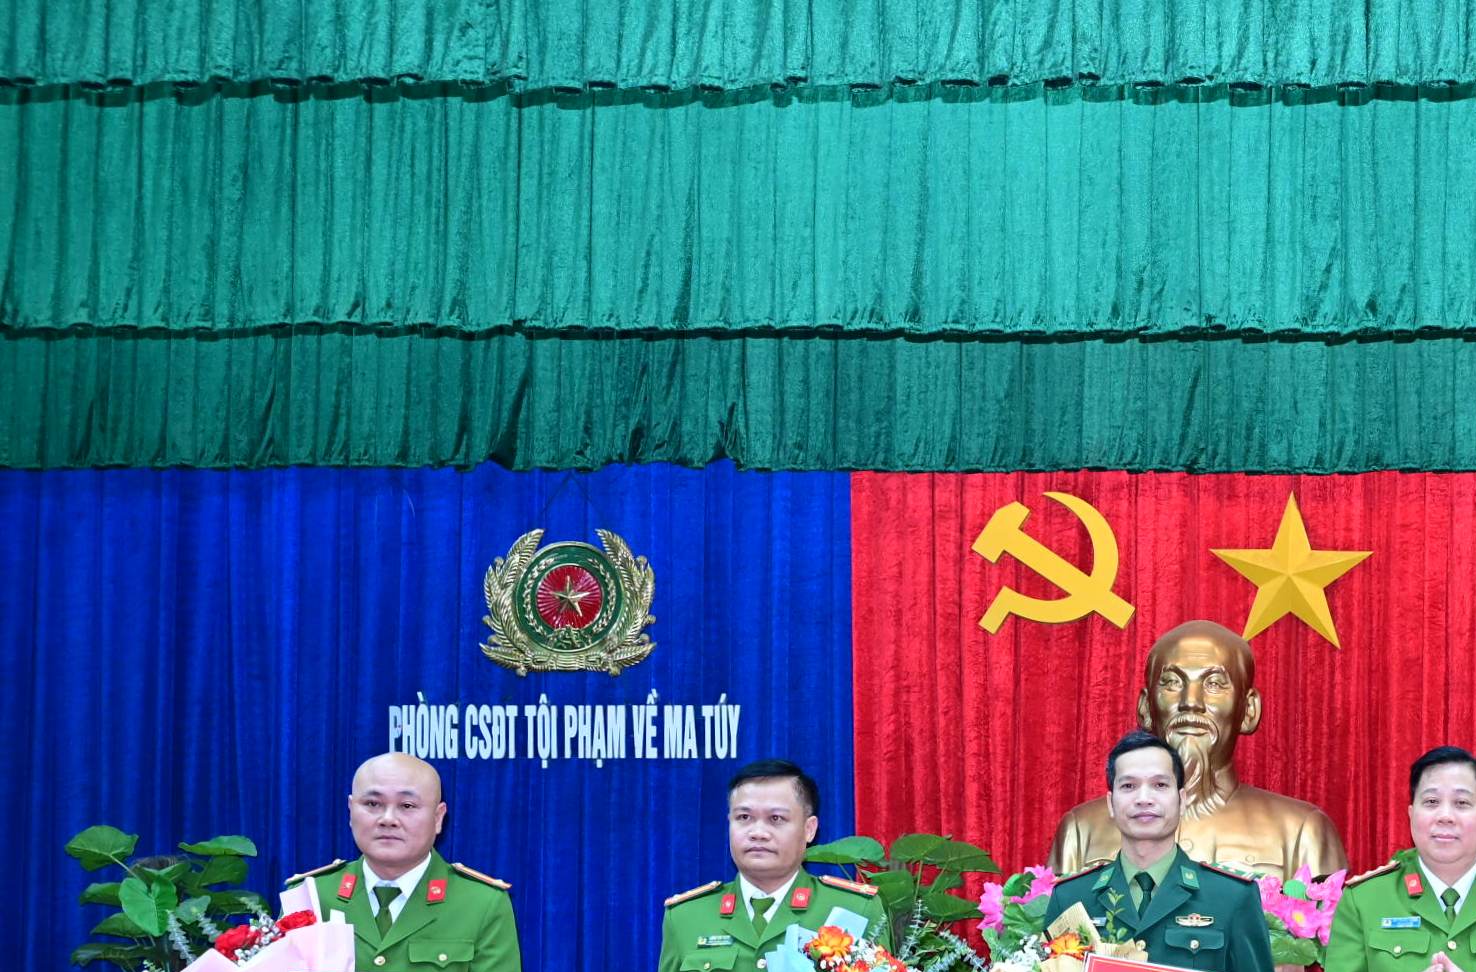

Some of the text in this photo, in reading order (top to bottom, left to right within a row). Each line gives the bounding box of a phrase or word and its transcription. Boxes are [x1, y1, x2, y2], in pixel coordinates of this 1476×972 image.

[389, 688, 741, 768] PHÒNG CSĐT TỘI PHẠM VỀ MA TÚY
